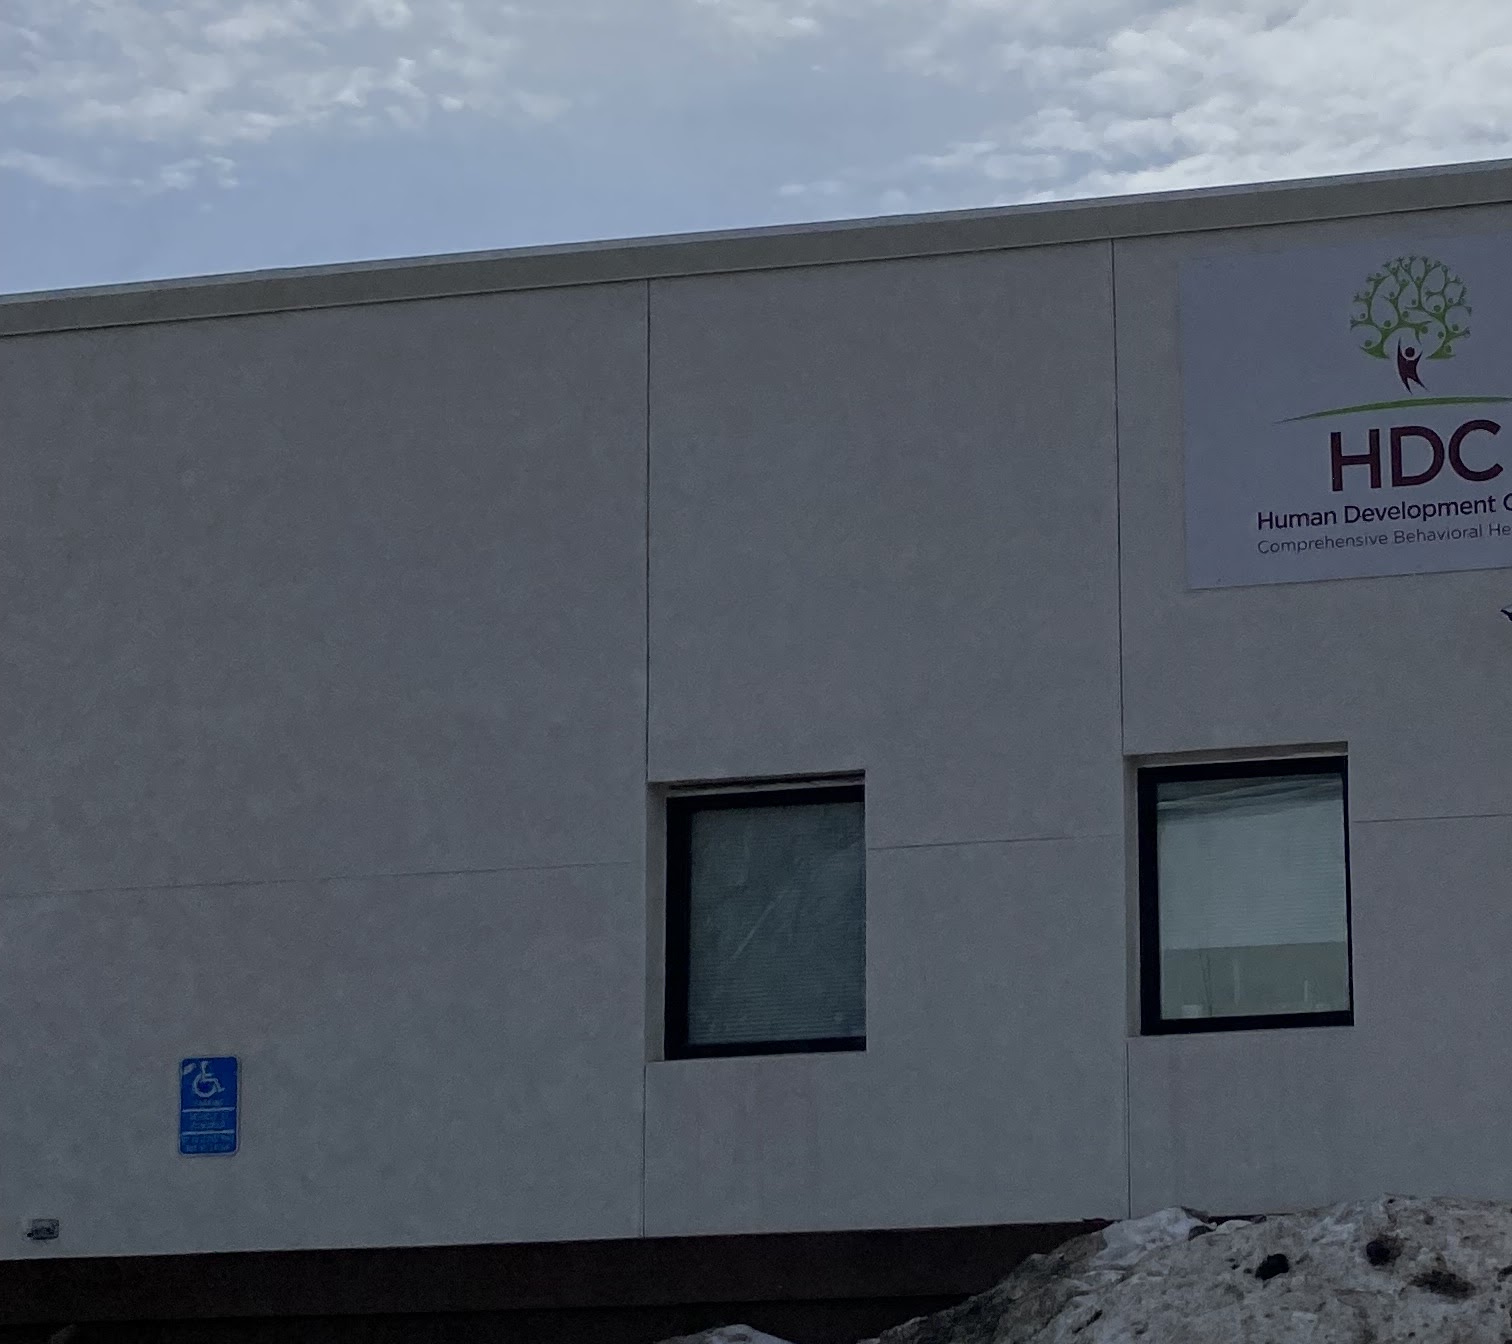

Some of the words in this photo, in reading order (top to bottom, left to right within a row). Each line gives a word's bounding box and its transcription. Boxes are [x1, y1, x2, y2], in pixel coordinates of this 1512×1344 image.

[1330, 419, 1504, 492] HDC
[1257, 510, 1337, 531] Human
[1344, 495, 1496, 524] Development
[1257, 533, 1388, 555] Comprehensive
[1393, 524, 1482, 544] Behavioral
